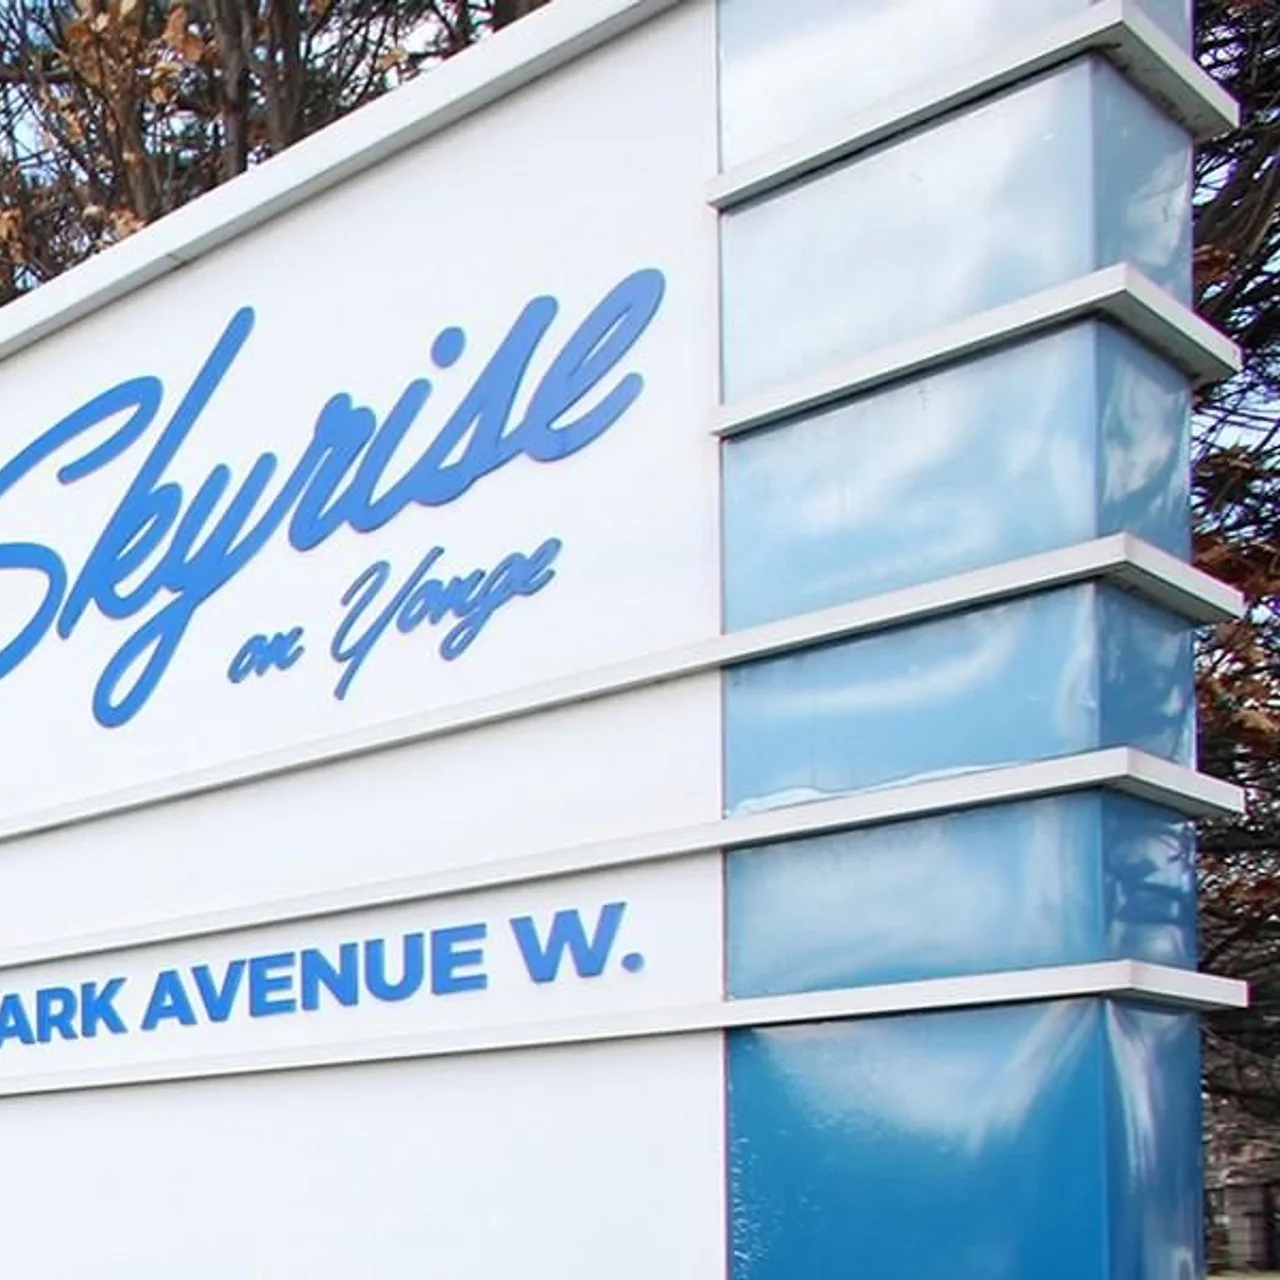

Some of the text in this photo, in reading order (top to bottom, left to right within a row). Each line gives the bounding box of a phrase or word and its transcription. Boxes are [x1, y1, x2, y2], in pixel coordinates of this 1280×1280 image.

[227, 536, 563, 700] on Yonge
[142, 922, 488, 1032] AVENUE
[509, 902, 646, 985] W.
